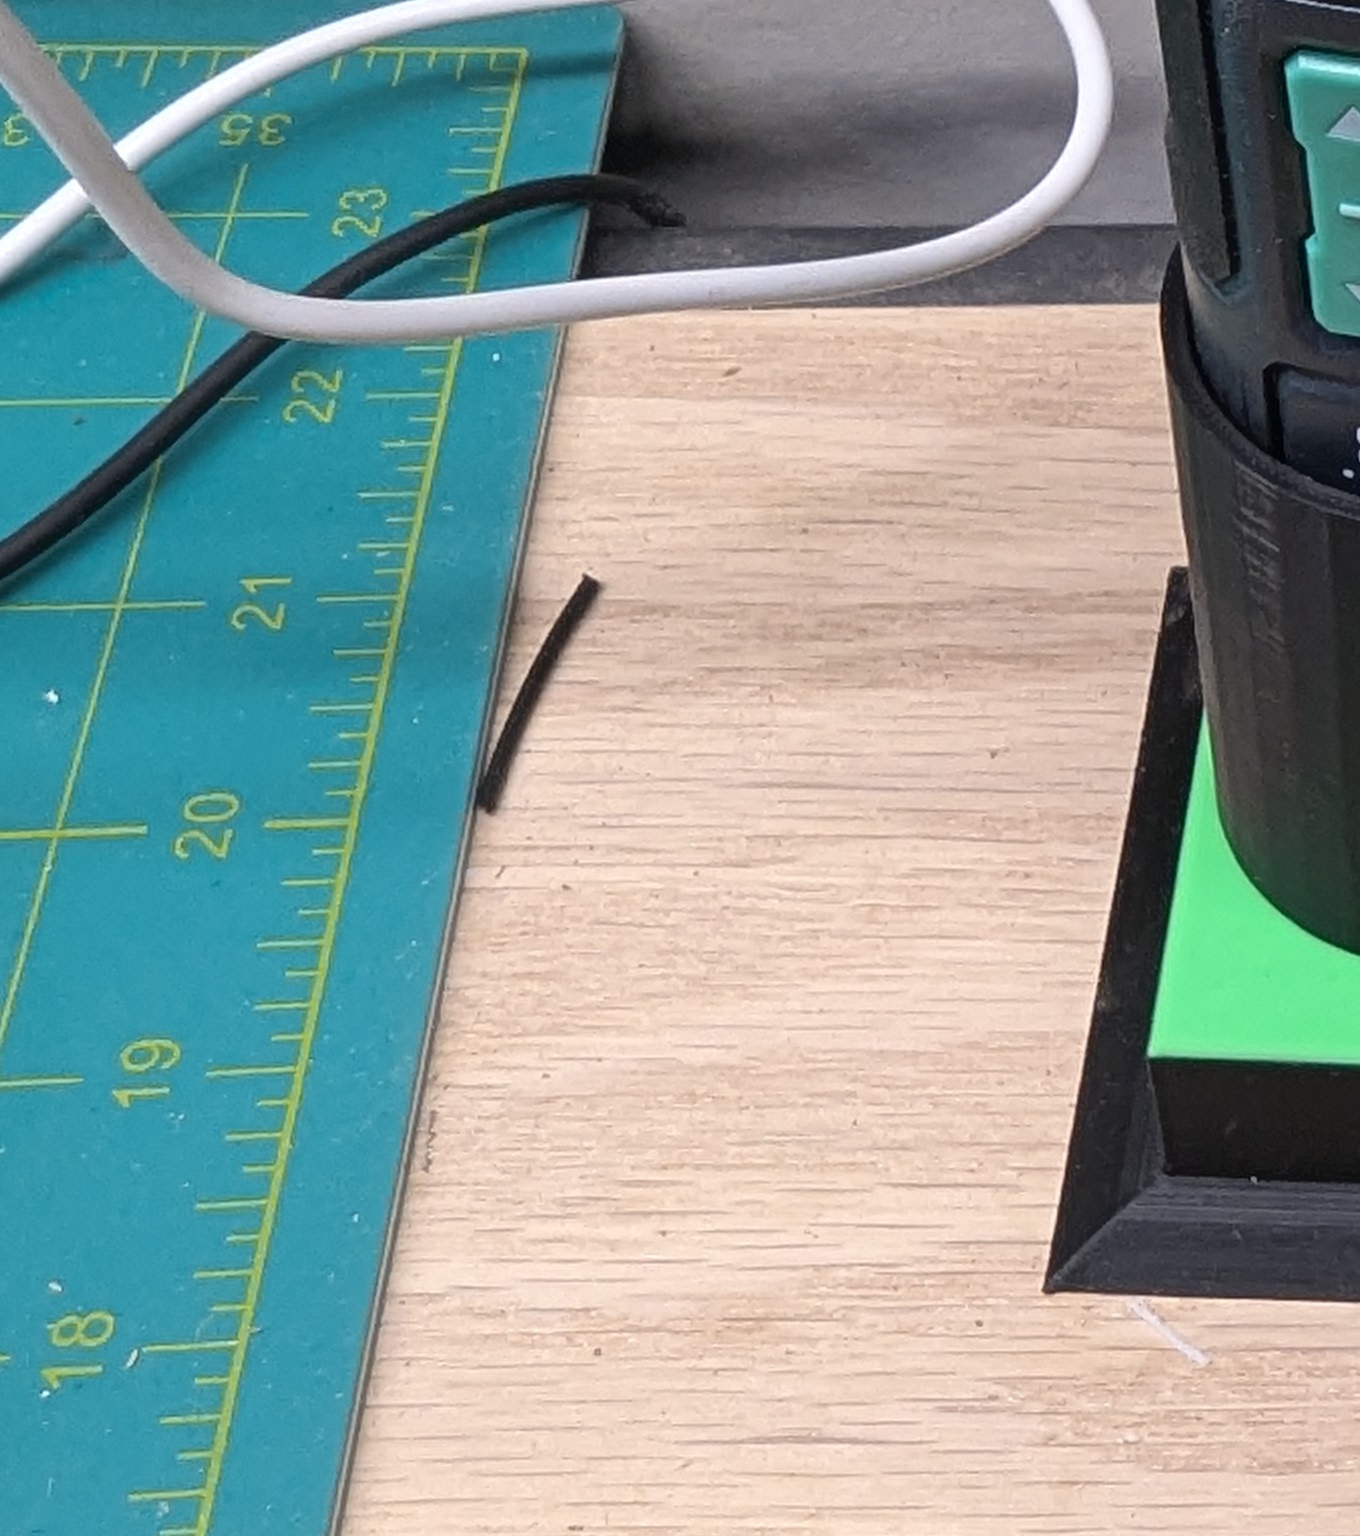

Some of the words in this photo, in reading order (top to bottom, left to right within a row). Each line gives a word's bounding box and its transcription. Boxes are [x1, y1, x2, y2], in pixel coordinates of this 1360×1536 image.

[218, 113, 292, 146] 35
[332, 187, 389, 239] 23
[283, 368, 344, 425] 22
[230, 575, 293, 630] 21
[174, 791, 241, 860] 20
[111, 1037, 182, 1108] 19
[39, 1310, 117, 1389] 18
